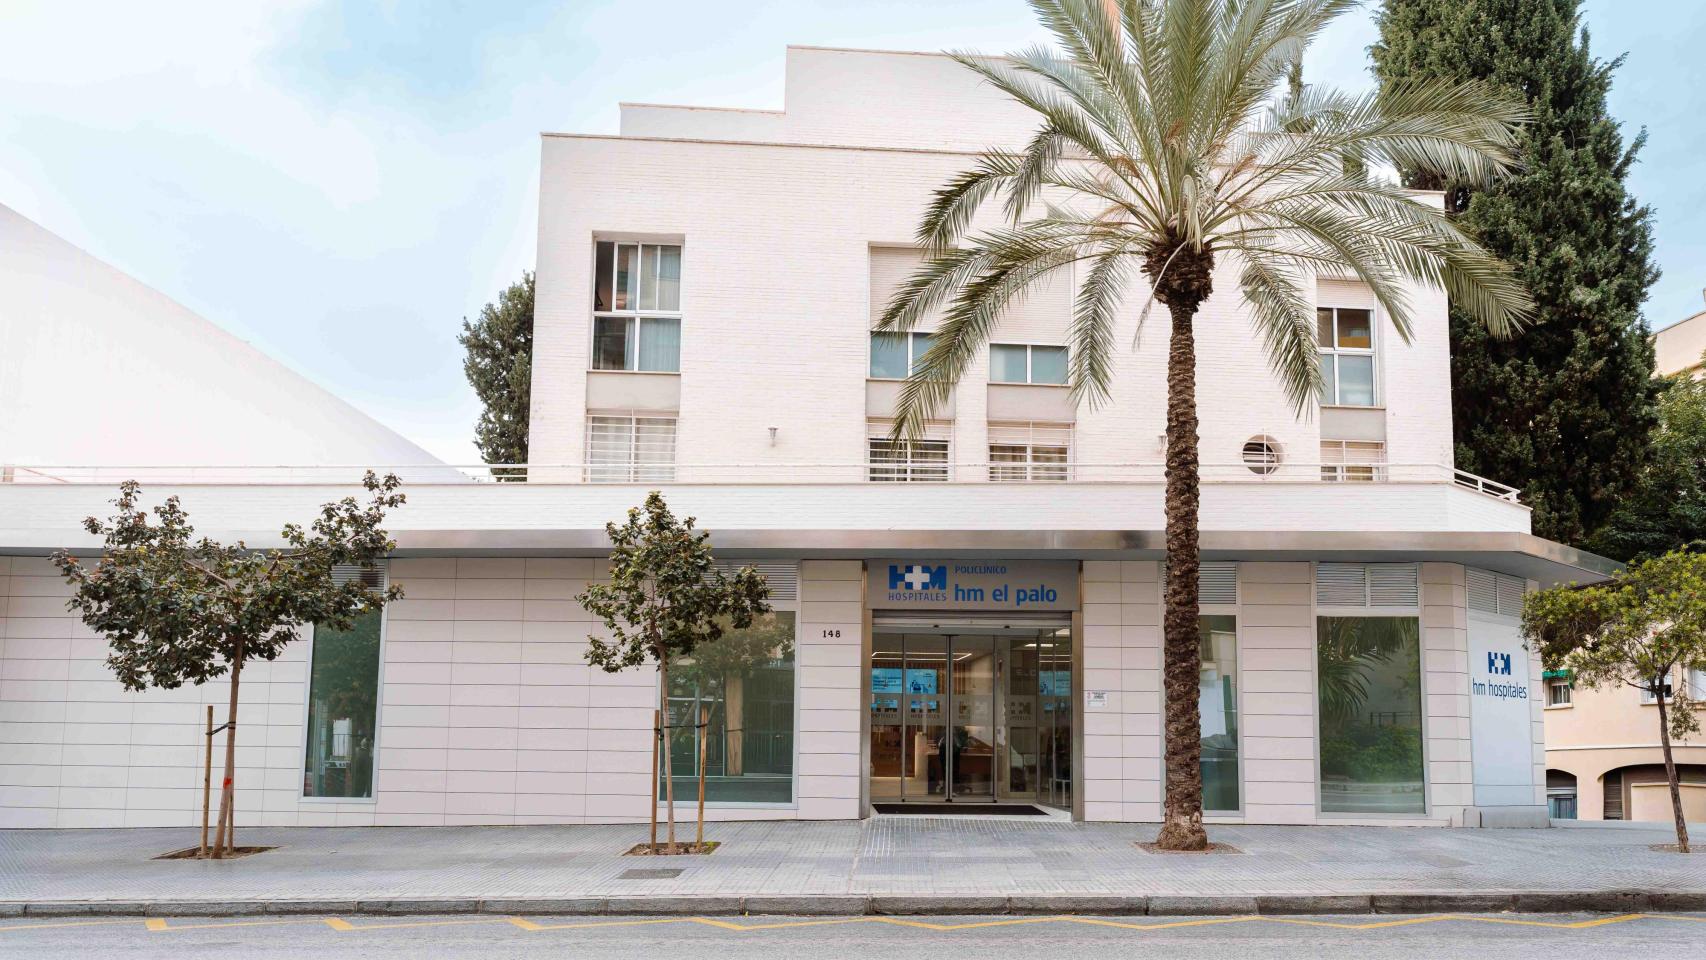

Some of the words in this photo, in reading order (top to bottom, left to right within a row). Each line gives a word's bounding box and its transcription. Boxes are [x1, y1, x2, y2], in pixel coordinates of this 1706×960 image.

[888, 592, 947, 601] HOSPITALES
[954, 583, 984, 602] hm
[992, 583, 1008, 602] el
[1016, 584, 1057, 606] palo
[823, 630, 841, 638] 148
[1472, 677, 1486, 695] hm
[1488, 678, 1527, 701] hospitales
